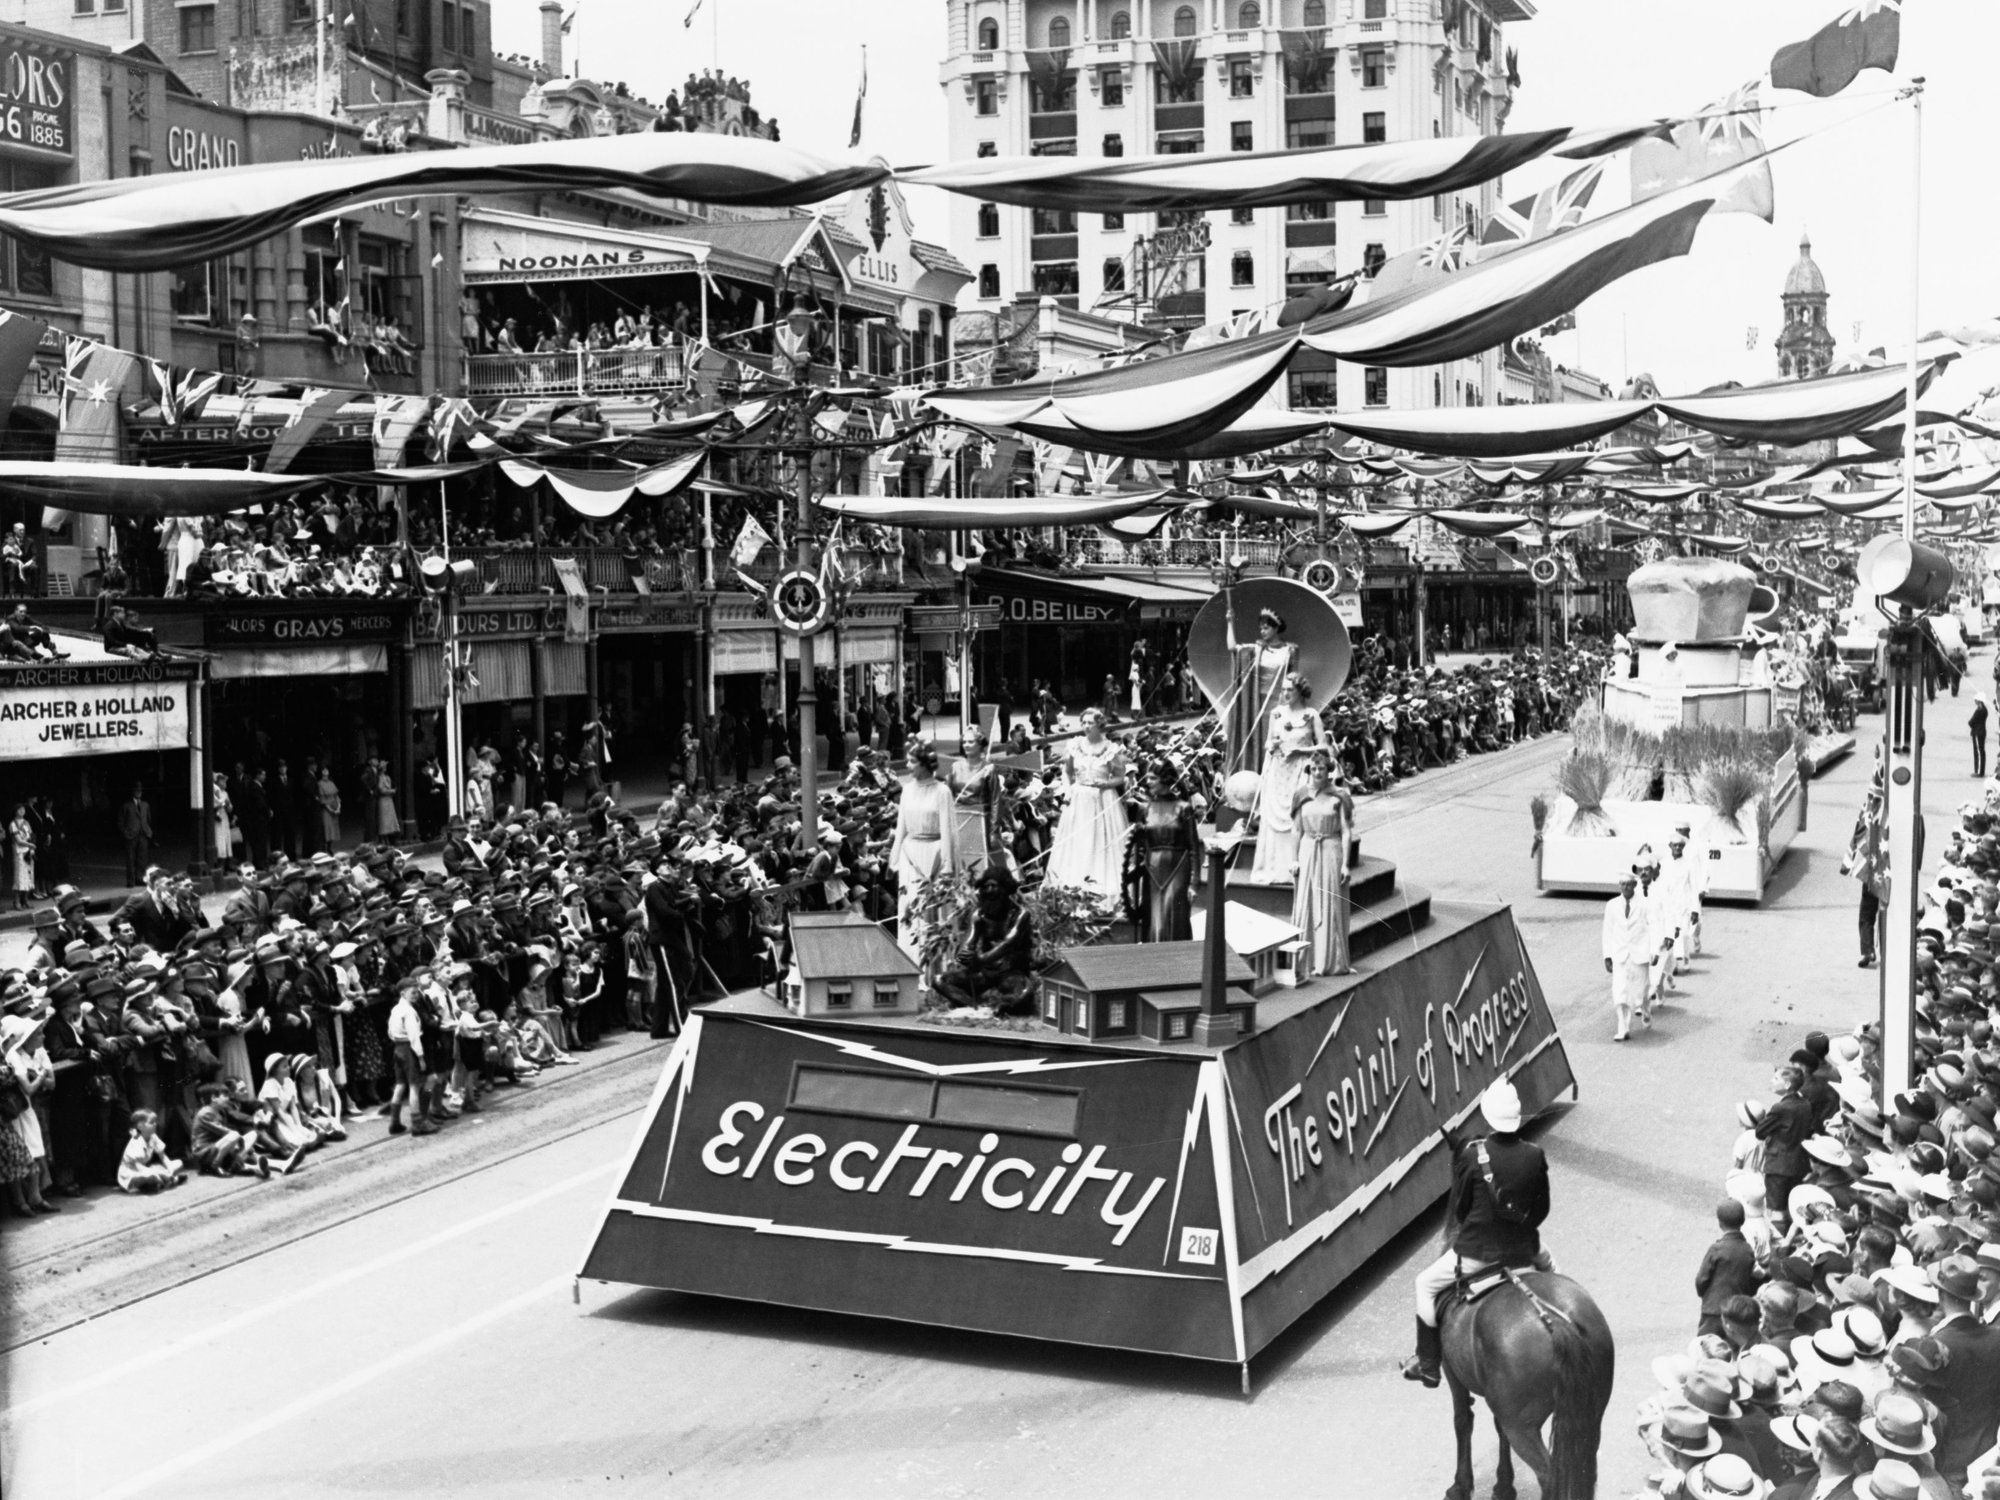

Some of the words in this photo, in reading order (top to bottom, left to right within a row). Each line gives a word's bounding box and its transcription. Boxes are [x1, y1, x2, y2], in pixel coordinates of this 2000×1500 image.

[0, 51, 65, 108] ORS
[30, 123, 64, 147] 1885
[169, 126, 239, 171] GRAND
[859, 255, 898, 283] ELLIS
[350, 616, 392, 630] MERCERS
[415, 611, 499, 636] BAOURS
[506, 612, 537, 631] LTD.
[15, 668, 79, 686] ARCHER
[83, 671, 92, 683] &
[95, 665, 163, 682] HOLLAND
[0, 700, 78, 721] ARCHER
[82, 702, 92, 717] &
[95, 696, 175, 716] HOLLAND
[39, 719, 143, 742] JEWELLERS.
[1264, 1083, 1323, 1227] The
[1326, 1016, 1399, 1155] spirit
[1416, 1002, 1436, 1106] of
[1442, 970, 1528, 1093] Progress
[701, 1101, 1167, 1247] Electricity
[1187, 1234, 1212, 1257] 218
